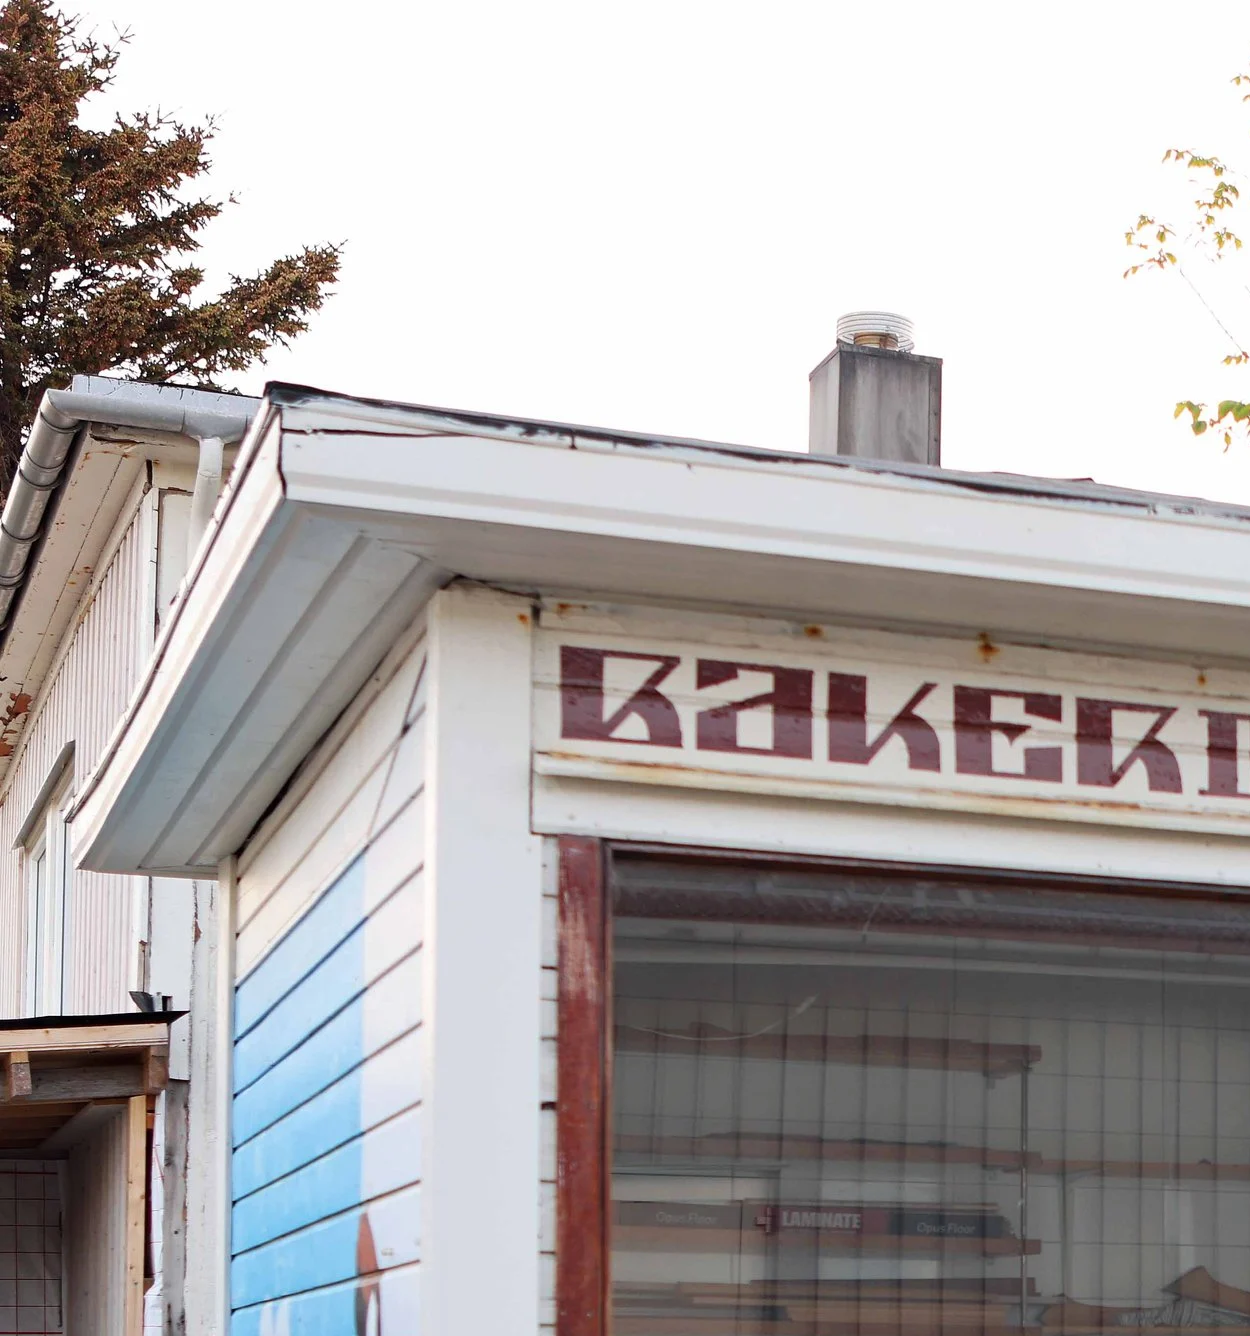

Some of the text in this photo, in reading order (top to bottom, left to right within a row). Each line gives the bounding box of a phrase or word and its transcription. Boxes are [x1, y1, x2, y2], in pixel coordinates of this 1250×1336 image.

[655, 1210, 718, 1226] Opus Floor
[781, 1209, 861, 1230] LAMINATE
[916, 1221, 976, 1235] Opus Floor
